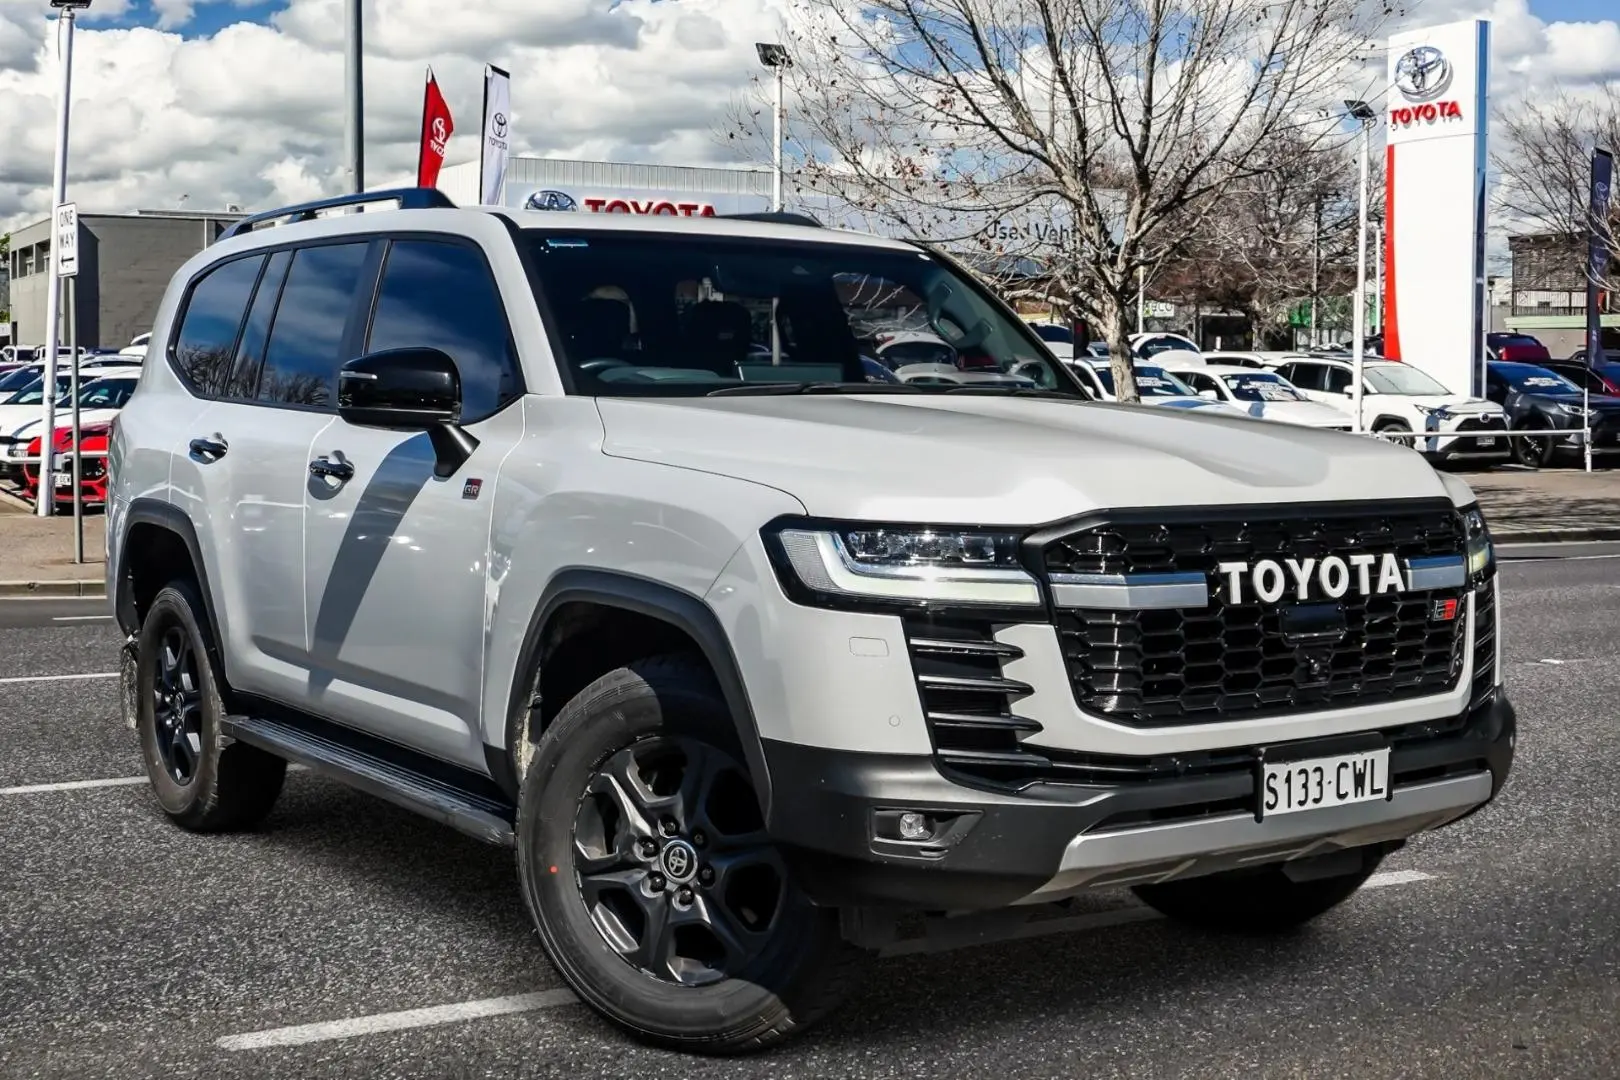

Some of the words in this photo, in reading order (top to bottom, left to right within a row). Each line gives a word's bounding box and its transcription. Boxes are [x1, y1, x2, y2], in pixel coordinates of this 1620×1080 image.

[1389, 101, 1462, 125] TOYOTA
[60, 209, 74, 227] ONE
[59, 232, 75, 249] WAY
[1035, 222, 1070, 241] Veh
[1218, 553, 1406, 605] TOYOTA
